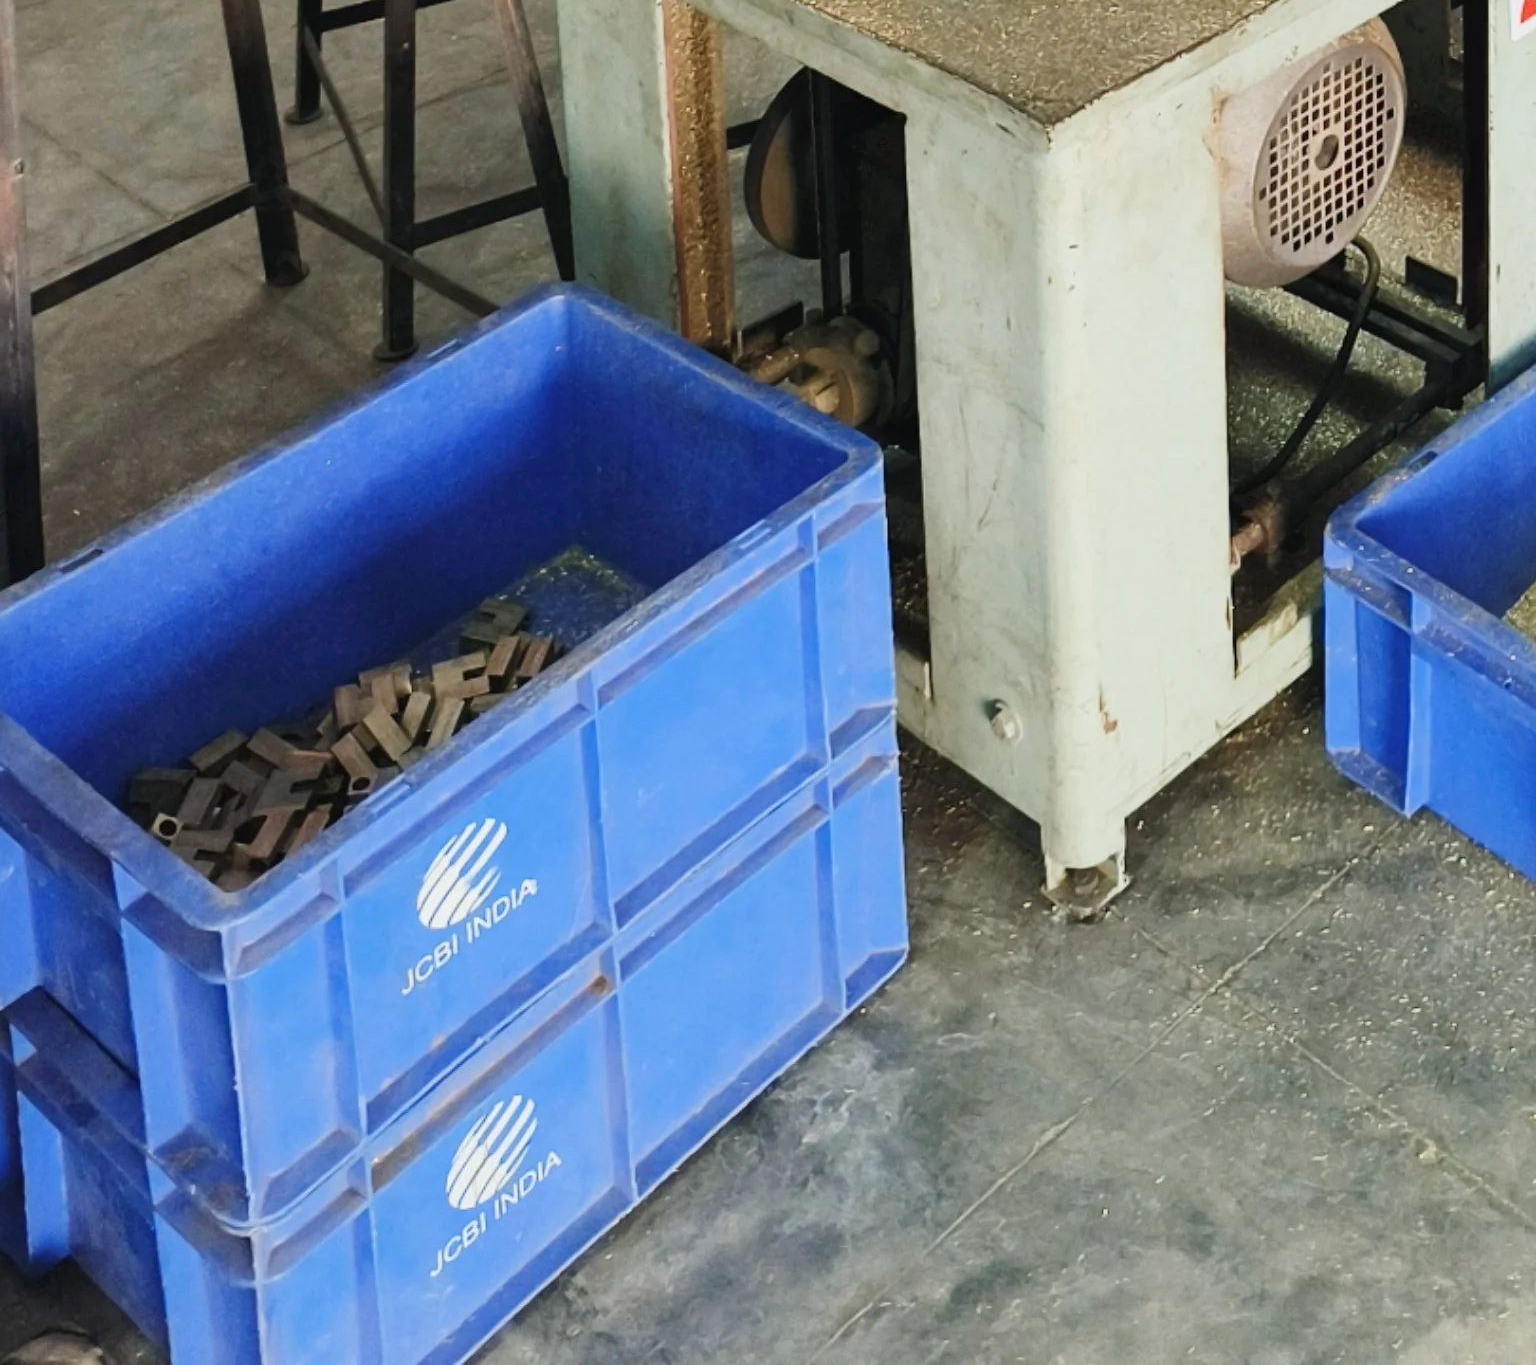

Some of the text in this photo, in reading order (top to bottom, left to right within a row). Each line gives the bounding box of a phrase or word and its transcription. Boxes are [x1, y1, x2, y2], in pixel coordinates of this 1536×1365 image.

[402, 879, 537, 996] JCBI INDIA
[430, 1151, 561, 1277] JCBI INDIA
